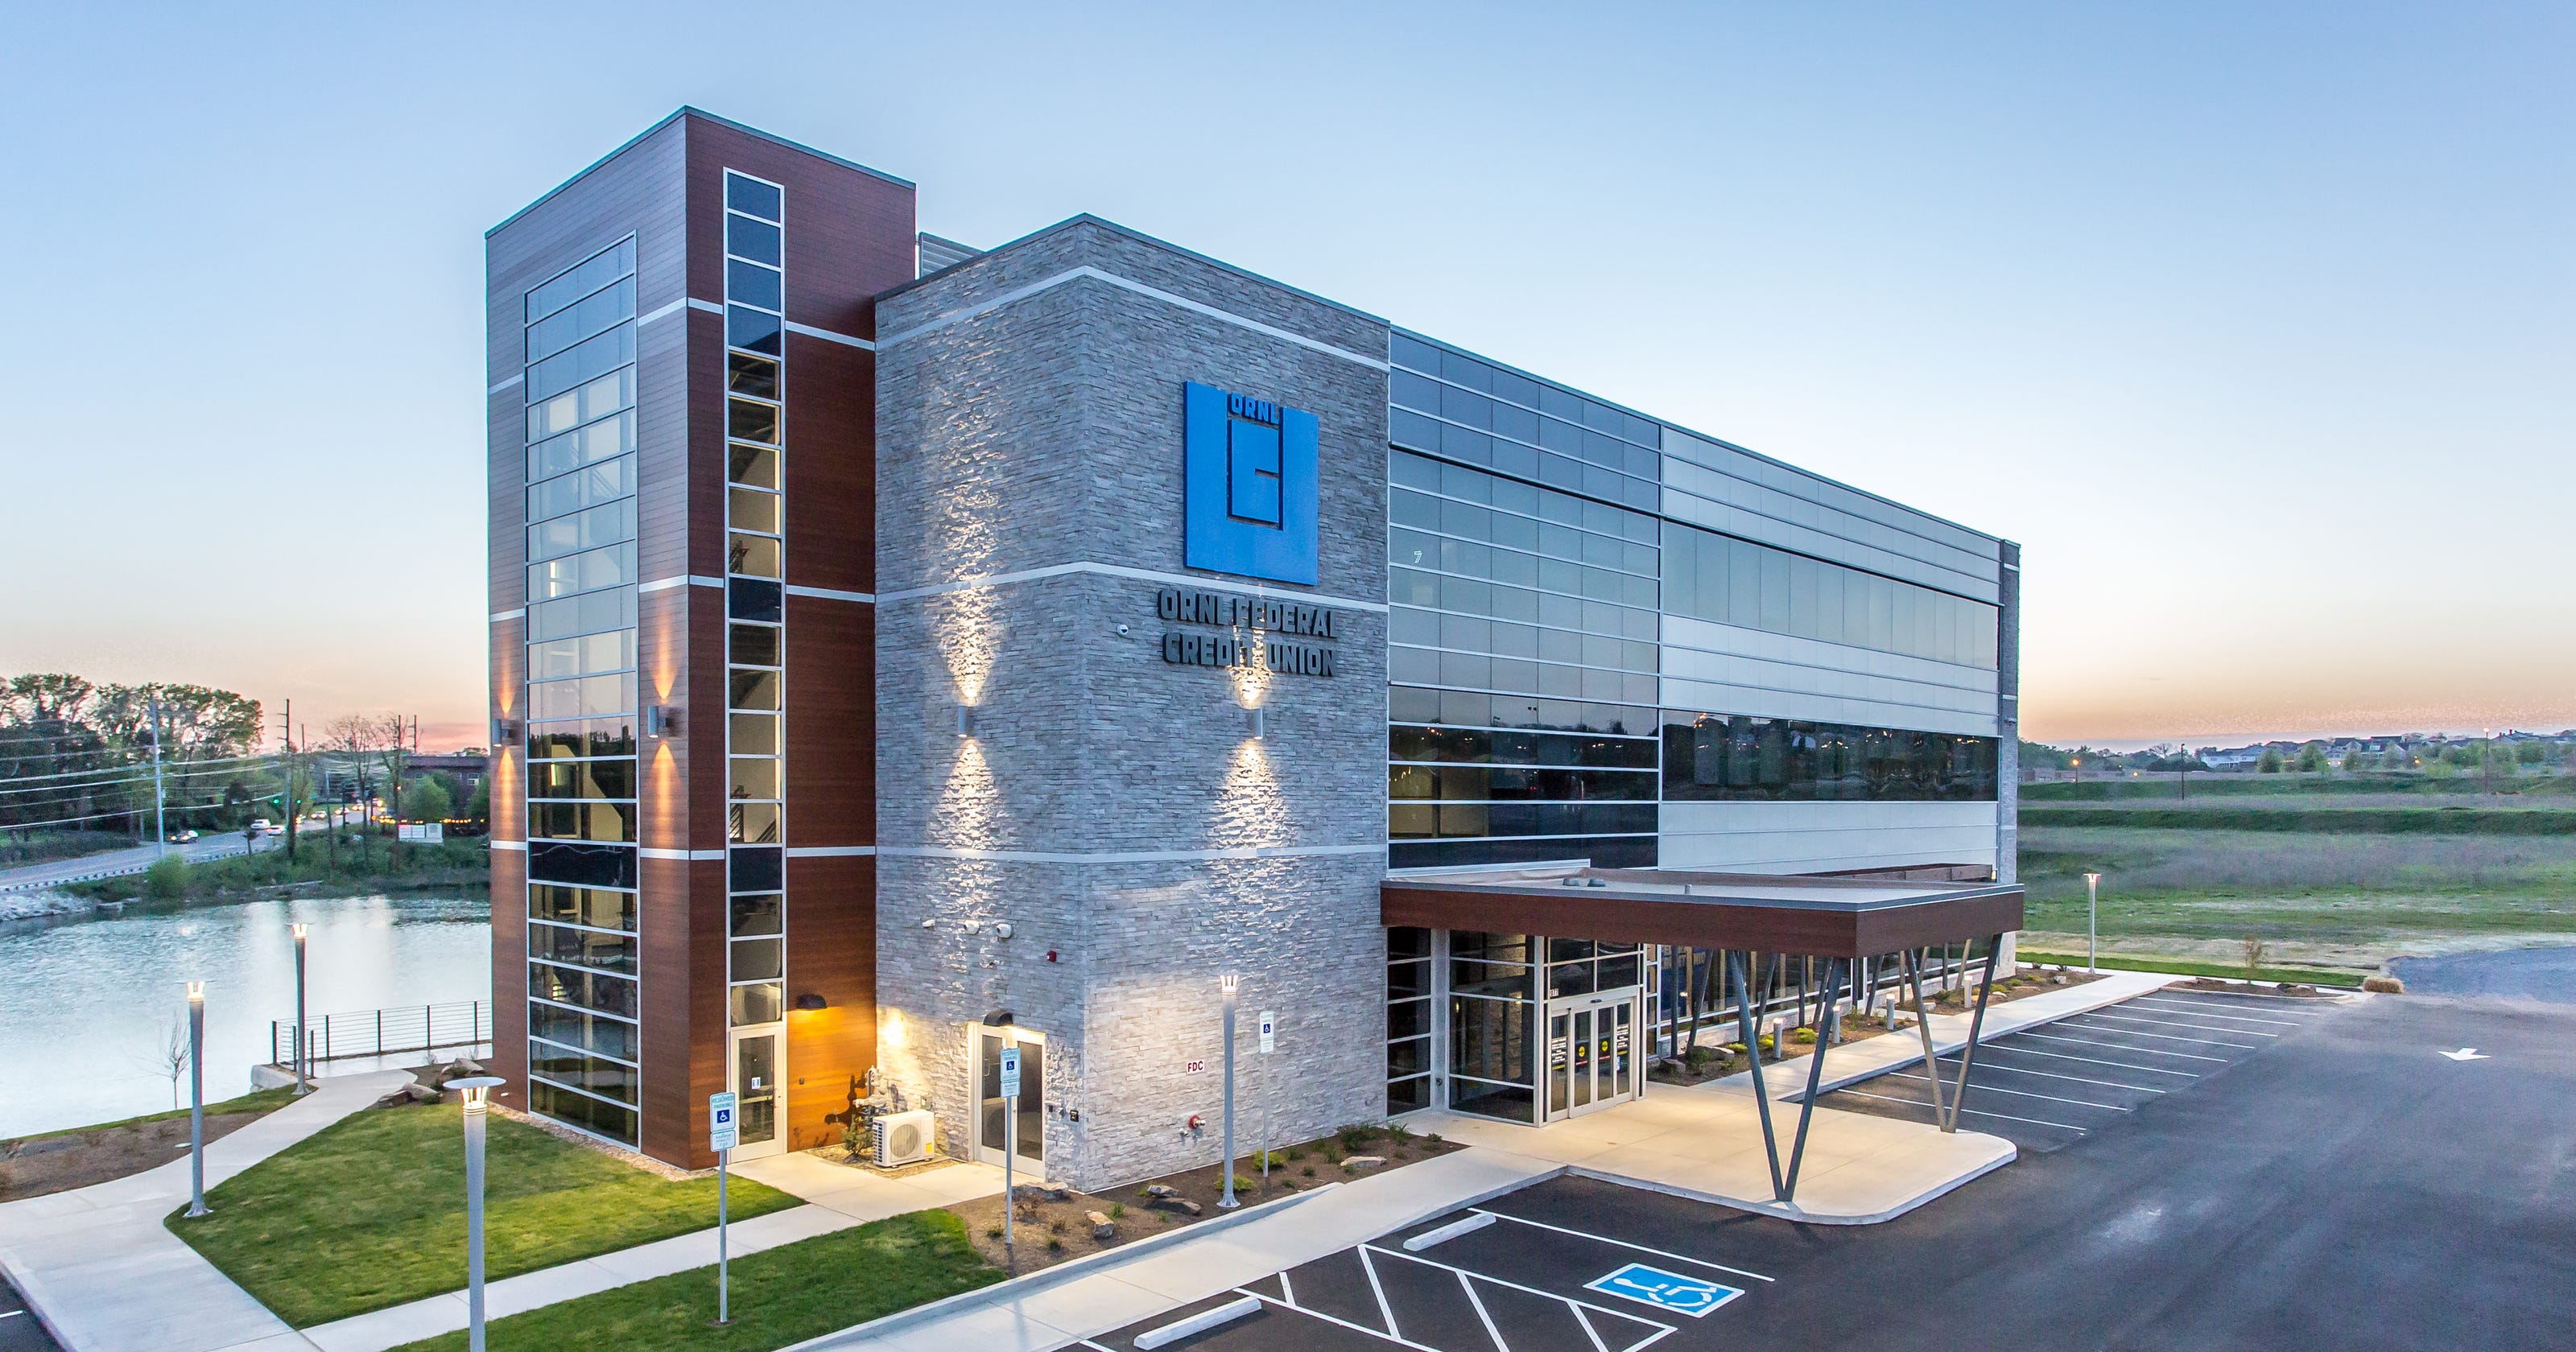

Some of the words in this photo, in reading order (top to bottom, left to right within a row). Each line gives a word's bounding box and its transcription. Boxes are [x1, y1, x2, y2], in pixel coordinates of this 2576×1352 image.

[1228, 392, 1279, 425] ORNL
[1158, 590, 1233, 625] ORNL
[1235, 598, 1339, 638] FEDERAL
[1163, 633, 1253, 668] CREDIT
[1266, 643, 1339, 677] UNION
[1187, 1060, 1203, 1073] FDC
